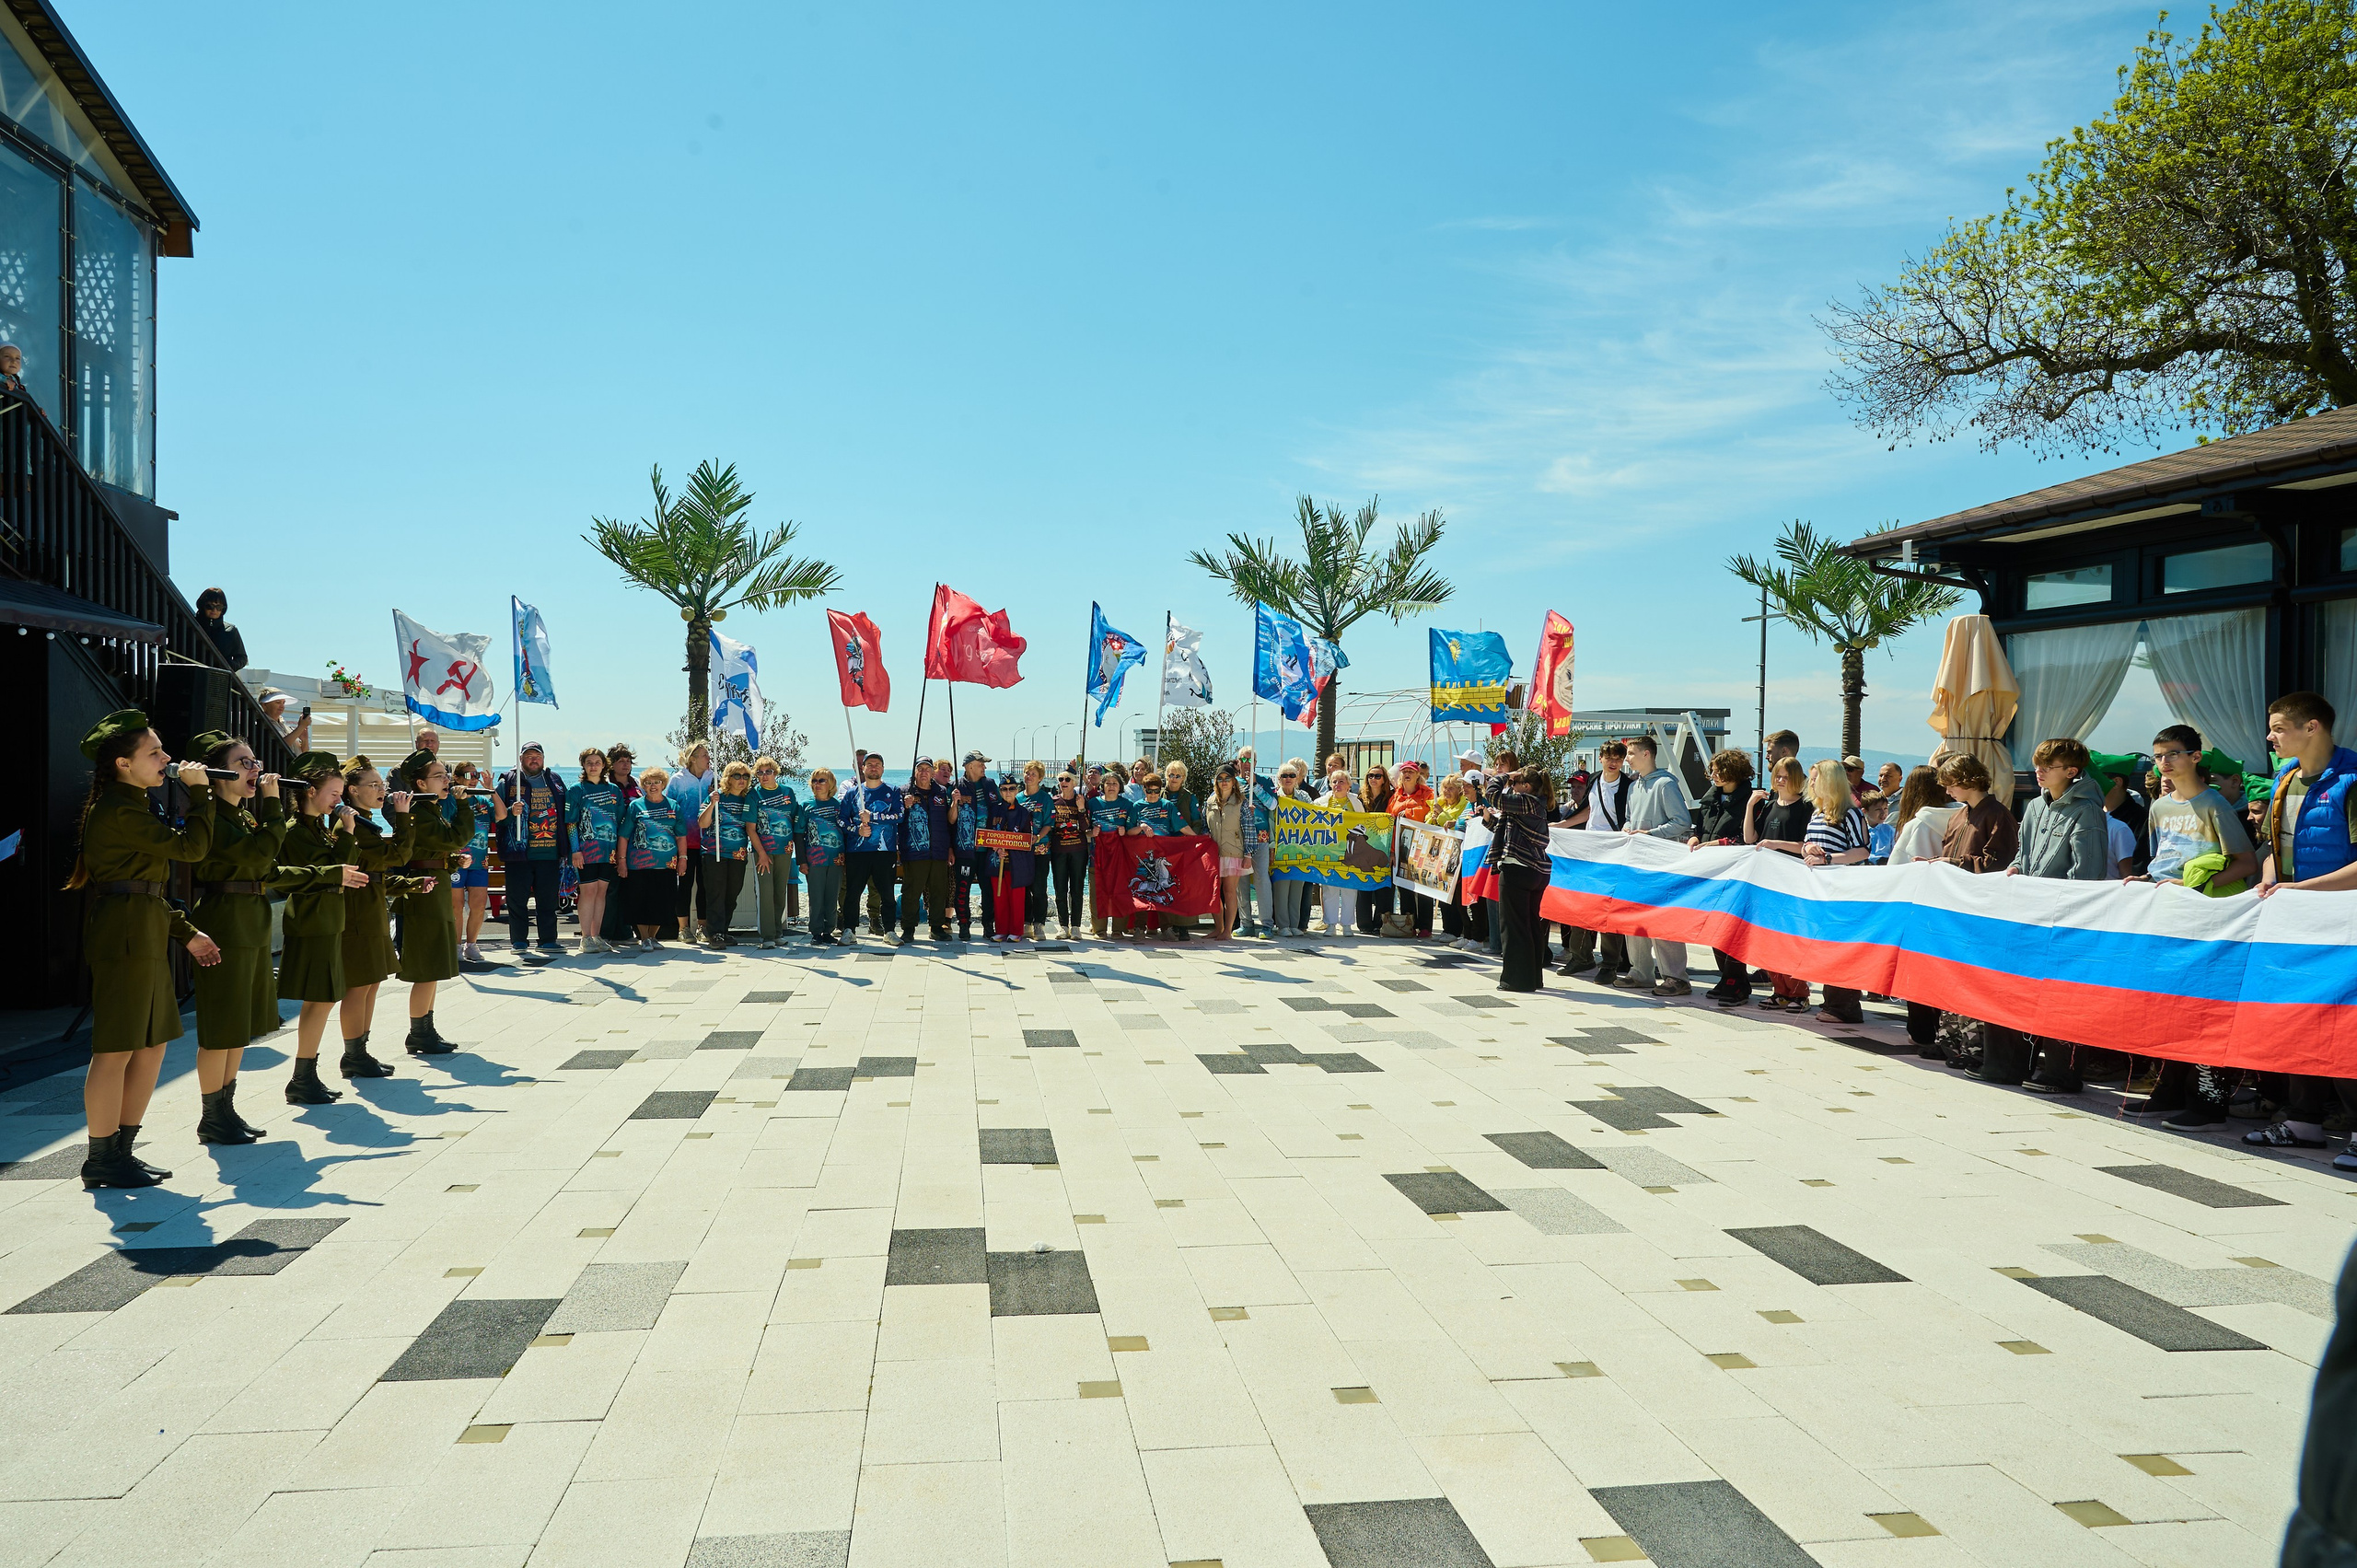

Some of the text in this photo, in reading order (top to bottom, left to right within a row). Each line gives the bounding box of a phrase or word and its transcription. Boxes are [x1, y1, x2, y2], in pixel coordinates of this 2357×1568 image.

[1605, 721, 1642, 730] ПРОГУЛКИ
[1701, 719, 1719, 728] УЛКИ
[1276, 806, 1344, 827] МОРЖИ
[2161, 814, 2198, 833] COSTA
[985, 838, 1030, 848] СЕВАСТОПОЛЬ
[1277, 827, 1338, 845] АНАПЫ
